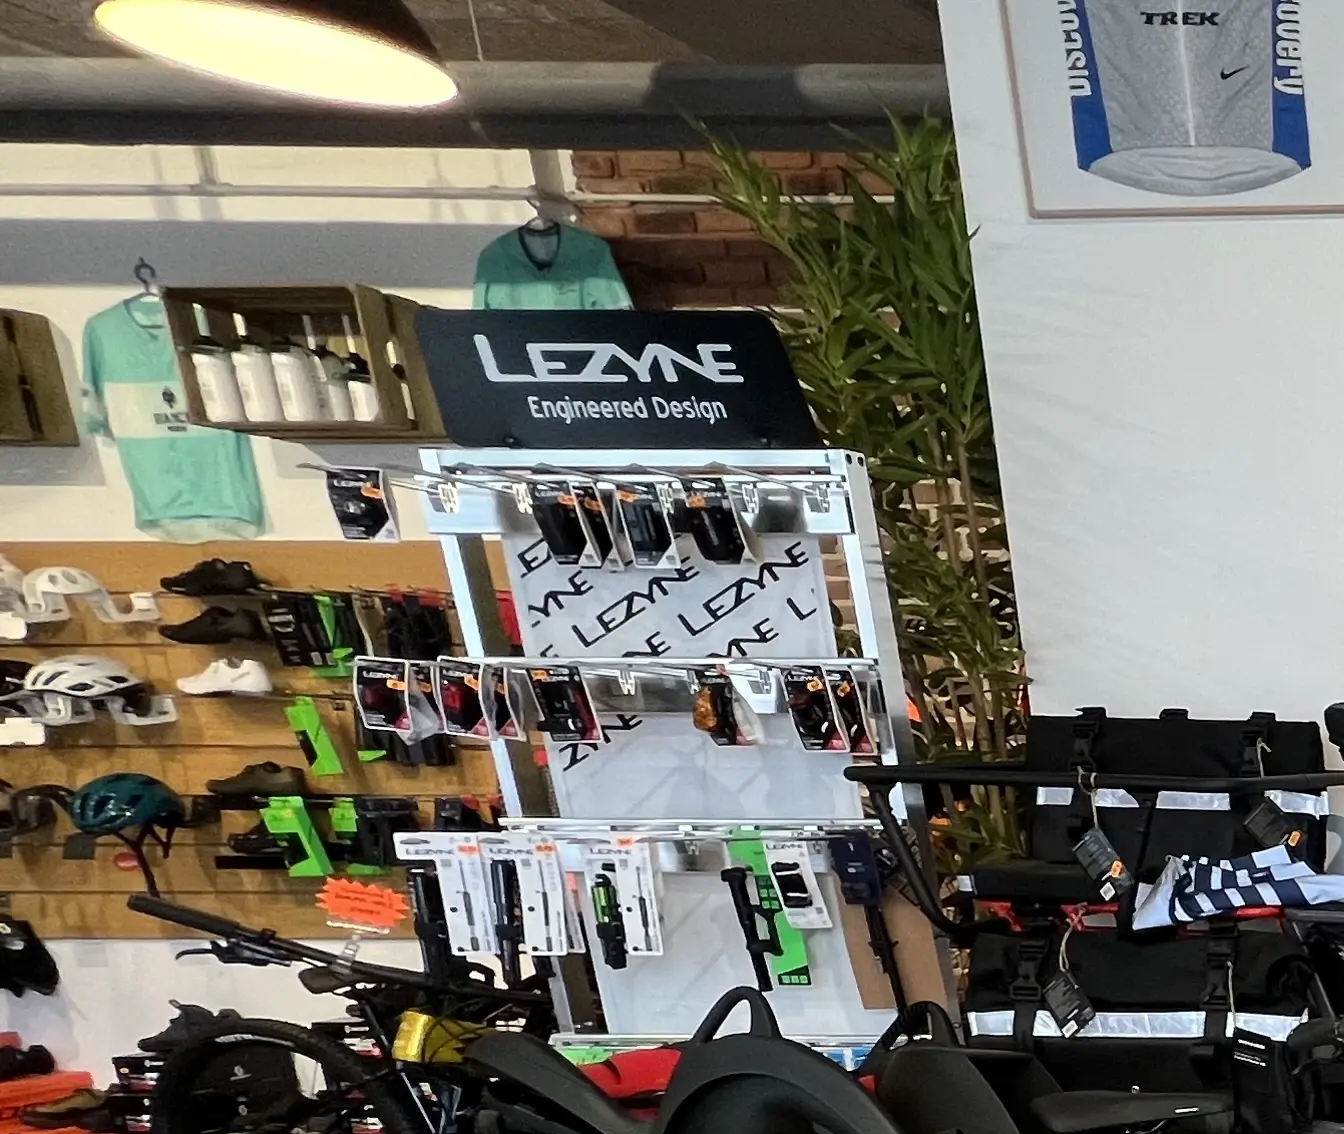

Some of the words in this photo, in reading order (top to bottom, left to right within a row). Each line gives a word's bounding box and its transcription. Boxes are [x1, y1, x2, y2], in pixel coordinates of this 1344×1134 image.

[1141, 11, 1220, 27] TREK
[473, 334, 745, 383] LEZYNE
[528, 395, 651, 424] Engineered
[654, 395, 728, 424] Design
[571, 556, 701, 648] LEZYNE
[677, 541, 810, 637] LEZYNE
